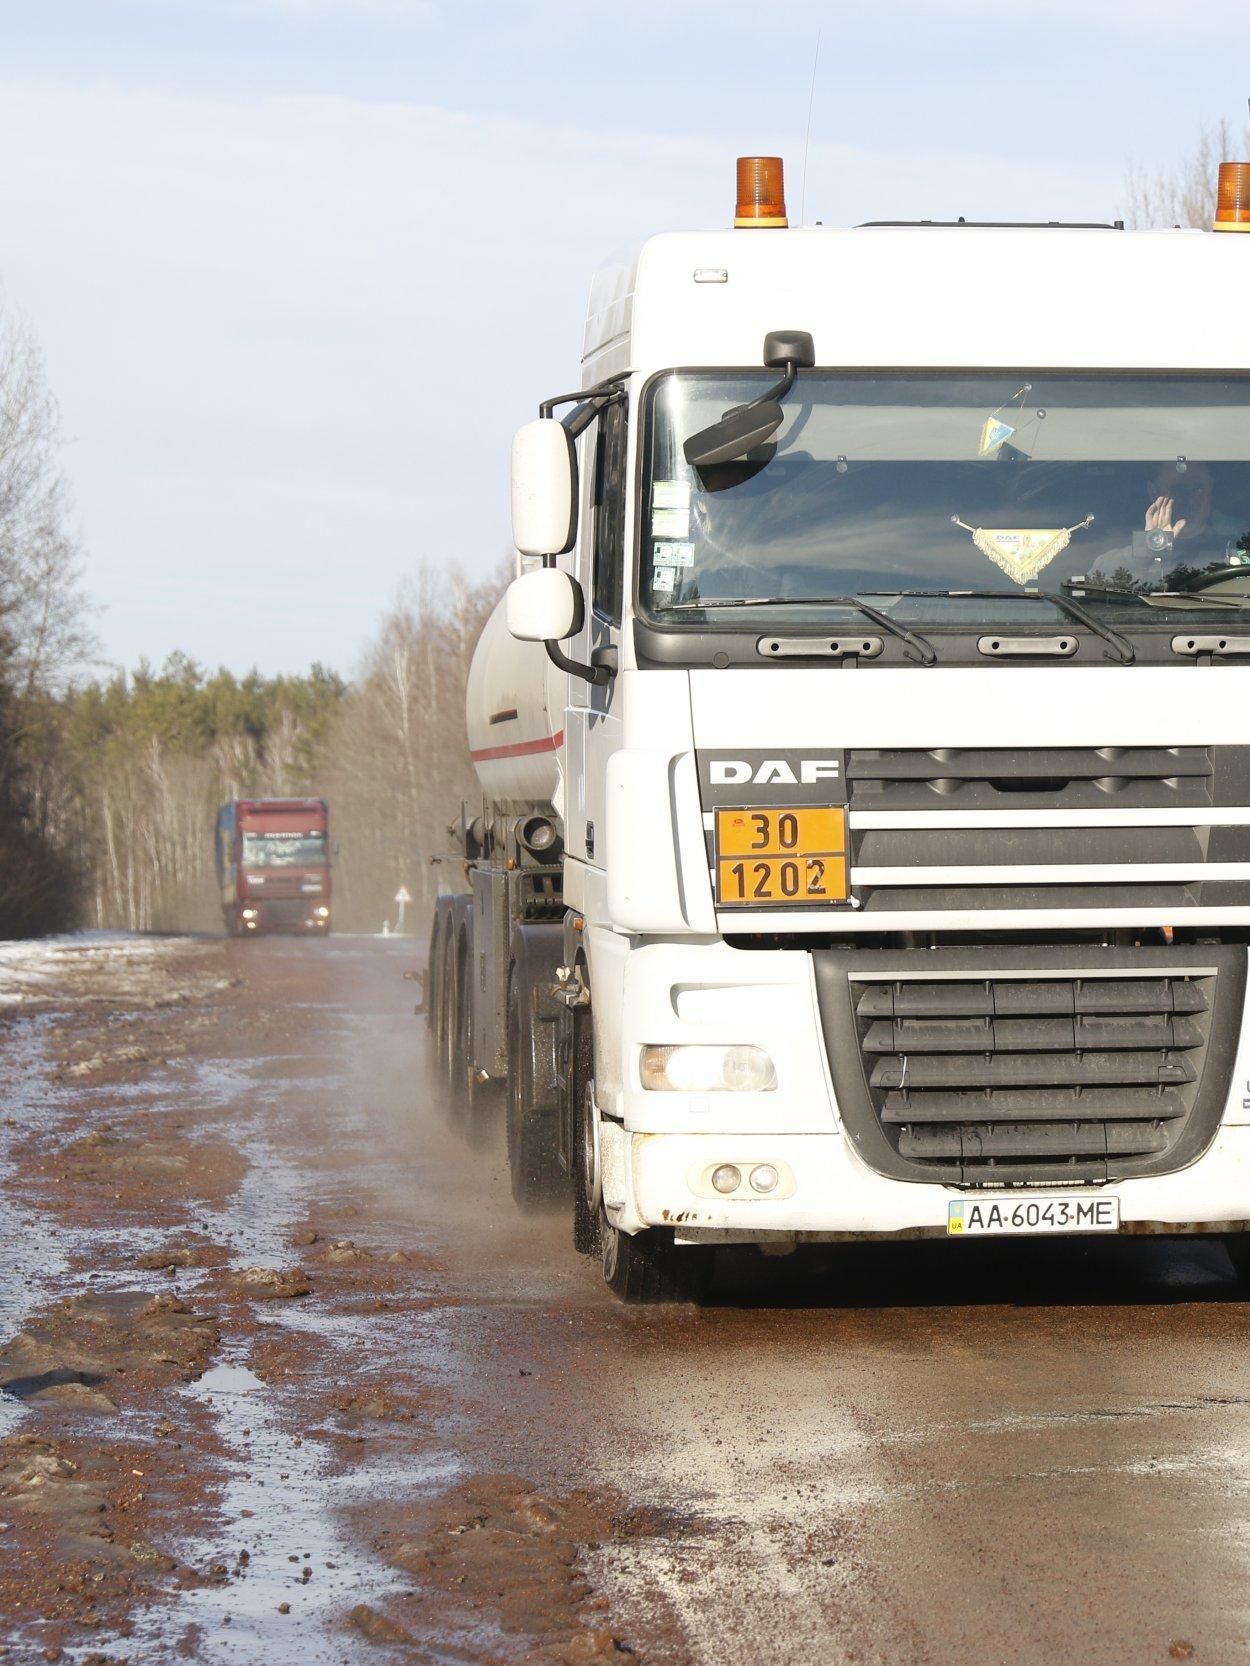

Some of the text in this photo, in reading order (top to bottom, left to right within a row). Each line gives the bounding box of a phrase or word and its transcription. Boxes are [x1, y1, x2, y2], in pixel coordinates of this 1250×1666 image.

[710, 760, 839, 785] DAF
[751, 813, 799, 850] 30
[731, 859, 826, 898] 1202
[951, 1222, 962, 1230] UA
